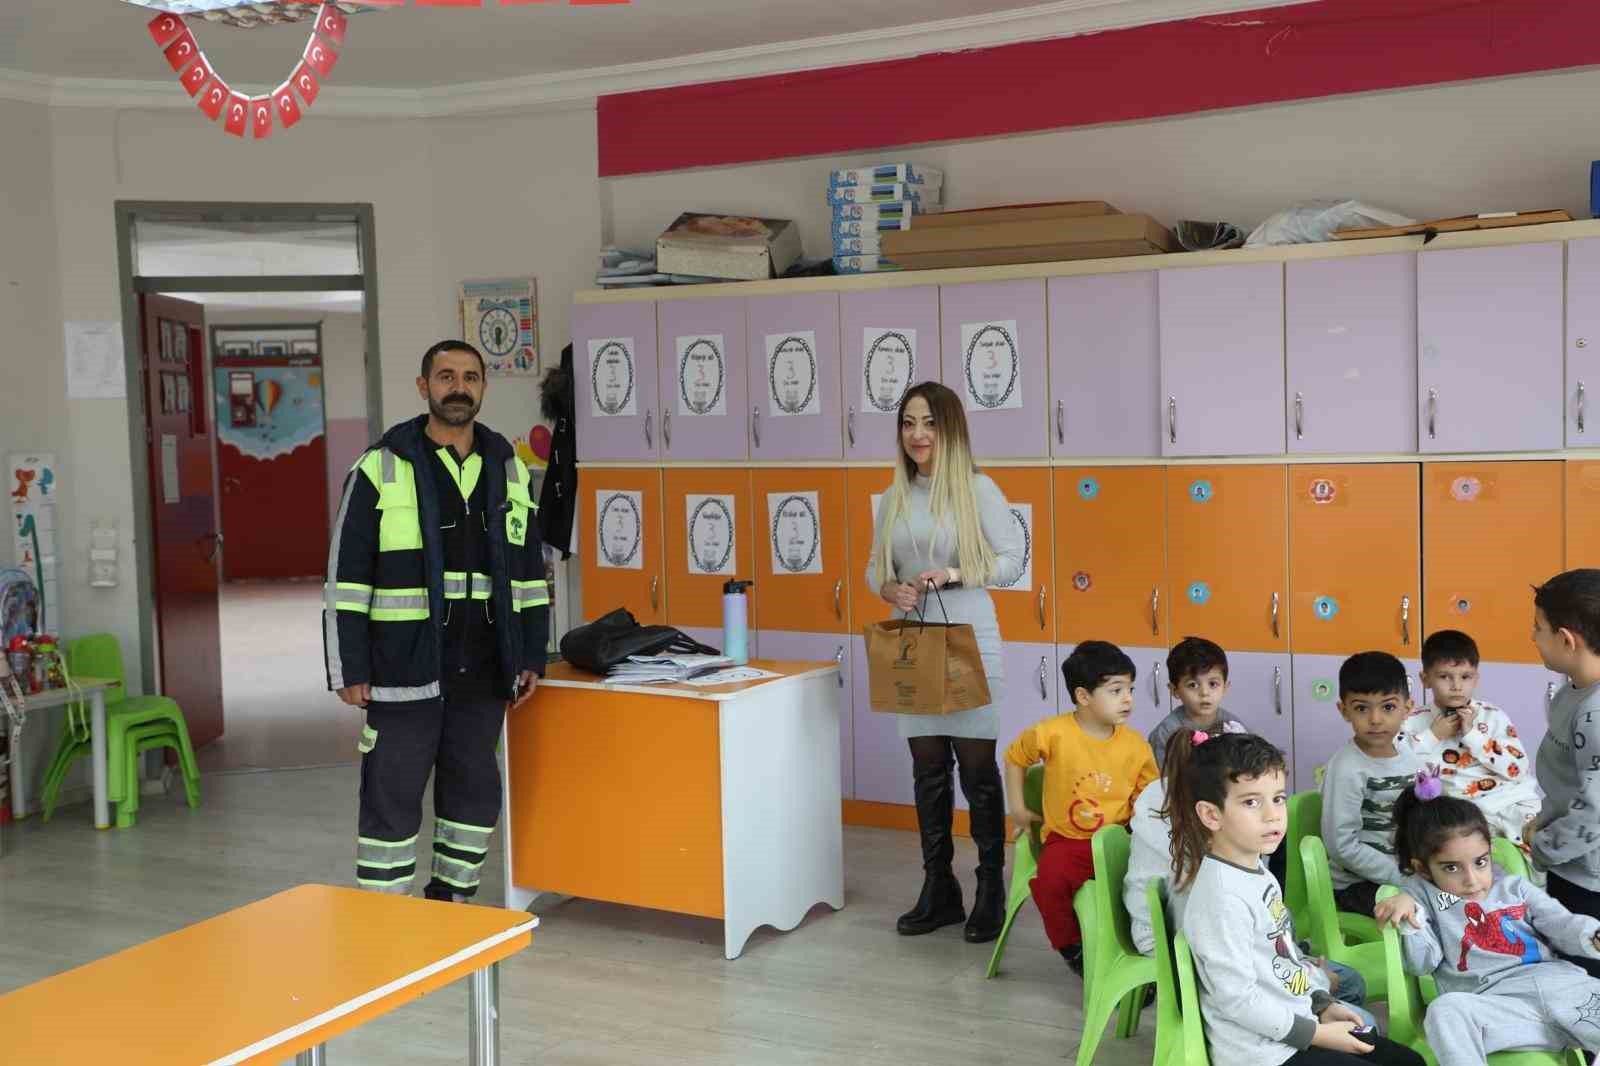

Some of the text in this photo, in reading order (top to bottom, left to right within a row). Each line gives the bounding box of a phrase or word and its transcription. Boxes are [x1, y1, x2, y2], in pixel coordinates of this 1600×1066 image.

[886, 355, 896, 375] 3
[984, 350, 998, 369] 3
[785, 360, 796, 380] 3
[790, 521, 800, 540] 3
